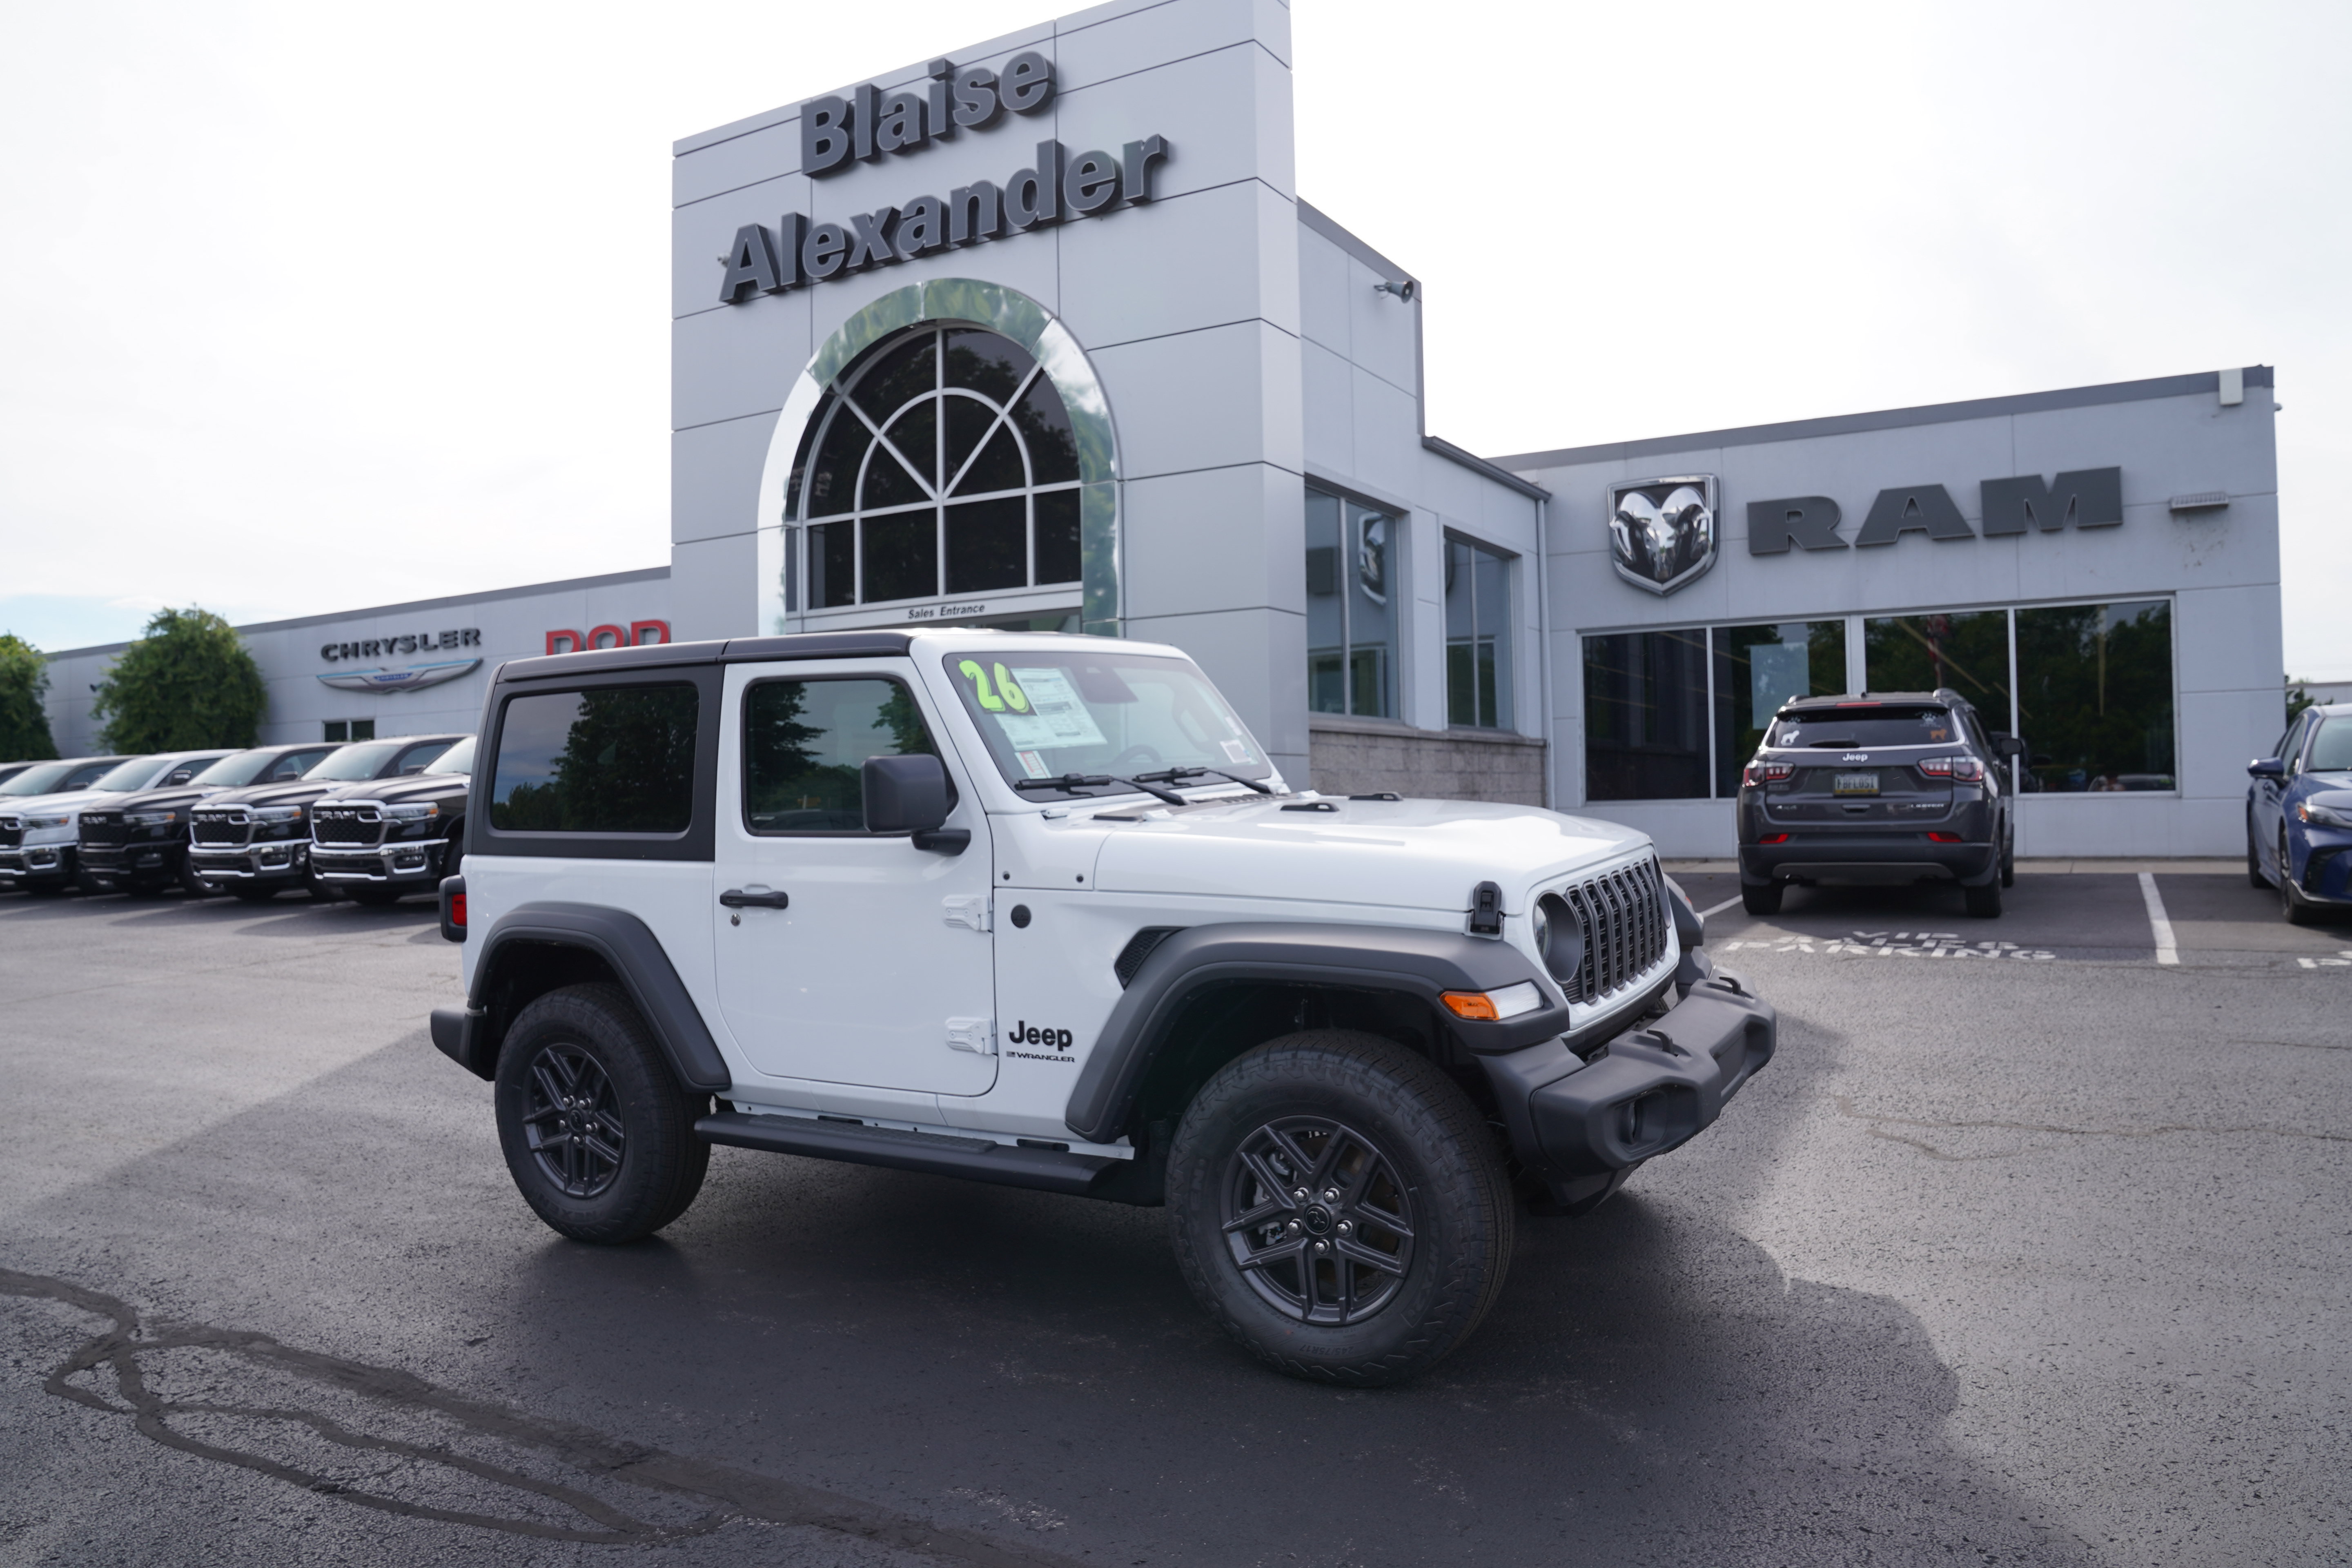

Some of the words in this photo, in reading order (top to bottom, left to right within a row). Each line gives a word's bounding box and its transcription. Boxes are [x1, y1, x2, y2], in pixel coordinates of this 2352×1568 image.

[801, 51, 1058, 179] Blaise
[719, 134, 1169, 304] Alexander
[1747, 466, 2123, 555] RAM
[908, 608, 934, 619] Sales
[940, 604, 985, 616] Entrance
[321, 628, 481, 662] CHRYSLER
[959, 659, 1029, 713] 26
[1842, 753, 1868, 762] Jeep
[1725, 942, 2056, 960] PARKING
[1853, 931, 1959, 940] VIP
[1009, 1020, 1072, 1051] Jeep
[1016, 1052, 1076, 1062] WRANGLER
